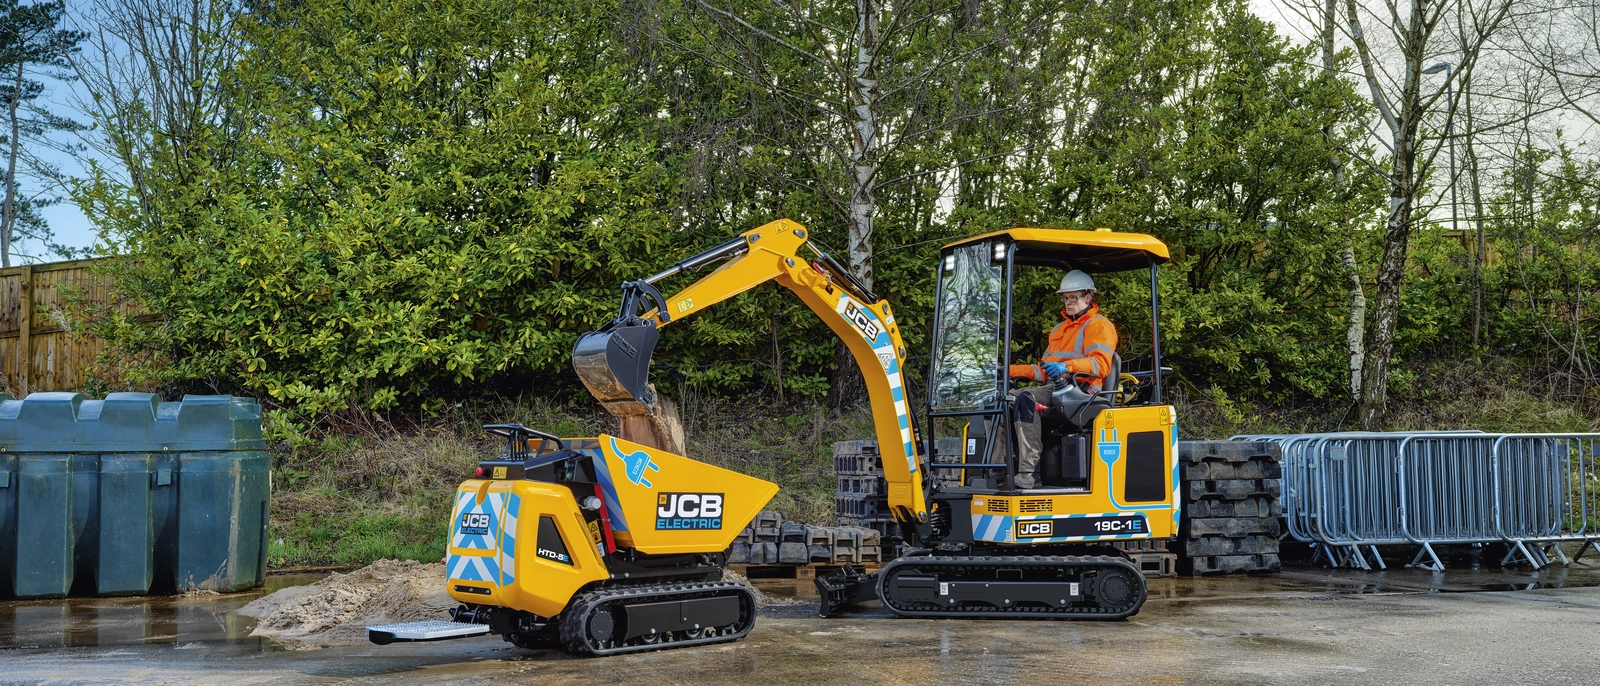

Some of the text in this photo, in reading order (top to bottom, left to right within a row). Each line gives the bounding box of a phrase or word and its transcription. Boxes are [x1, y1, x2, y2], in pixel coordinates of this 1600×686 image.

[846, 308, 877, 340] JCB
[658, 494, 722, 518] JCB
[462, 514, 490, 528] JCB
[656, 518, 721, 529] ELECTRIC
[1094, 519, 1142, 531] 19C-1E
[461, 527, 488, 535] ELECTRIC
[1020, 523, 1050, 534] JCB
[538, 548, 569, 562] HTD-5E
